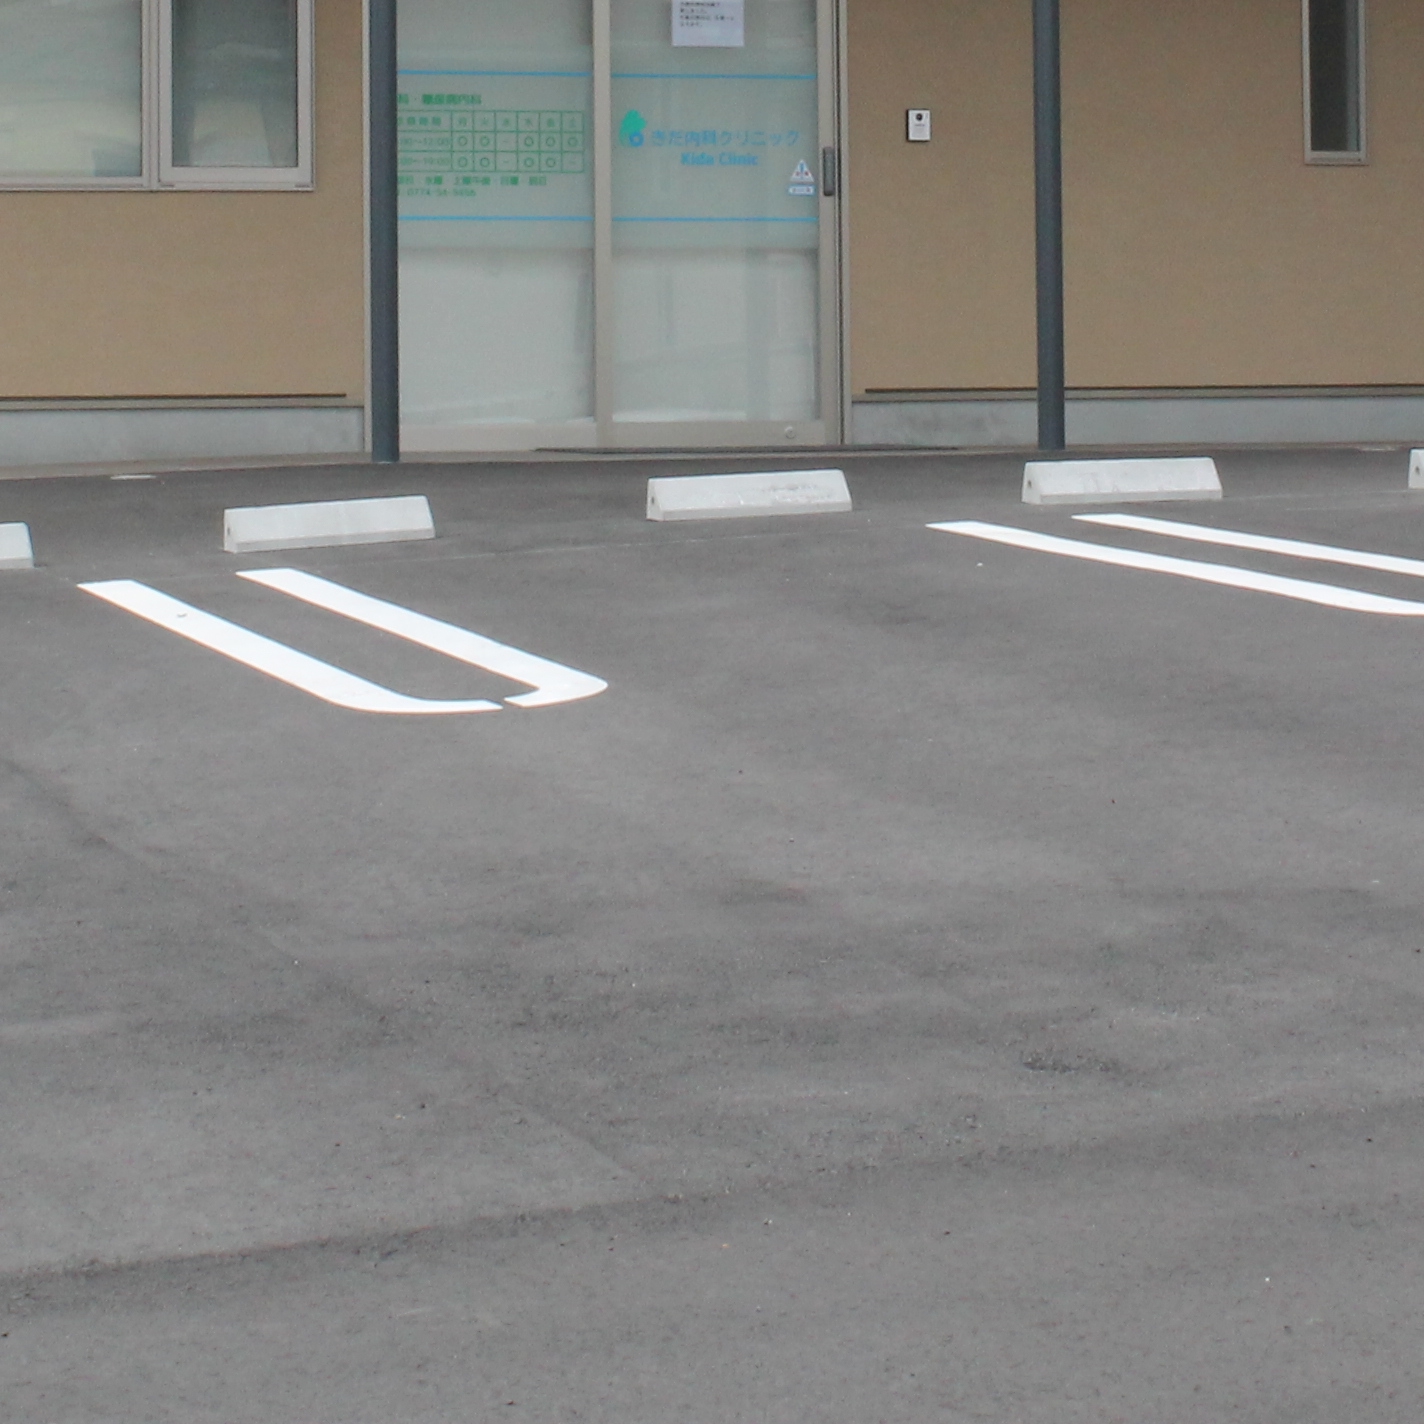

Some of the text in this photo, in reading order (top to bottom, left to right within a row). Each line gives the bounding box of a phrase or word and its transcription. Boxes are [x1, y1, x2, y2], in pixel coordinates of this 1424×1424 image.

[651, 130, 800, 147] きだ内科クリニック
[680, 152, 759, 166] Kida Clinic
